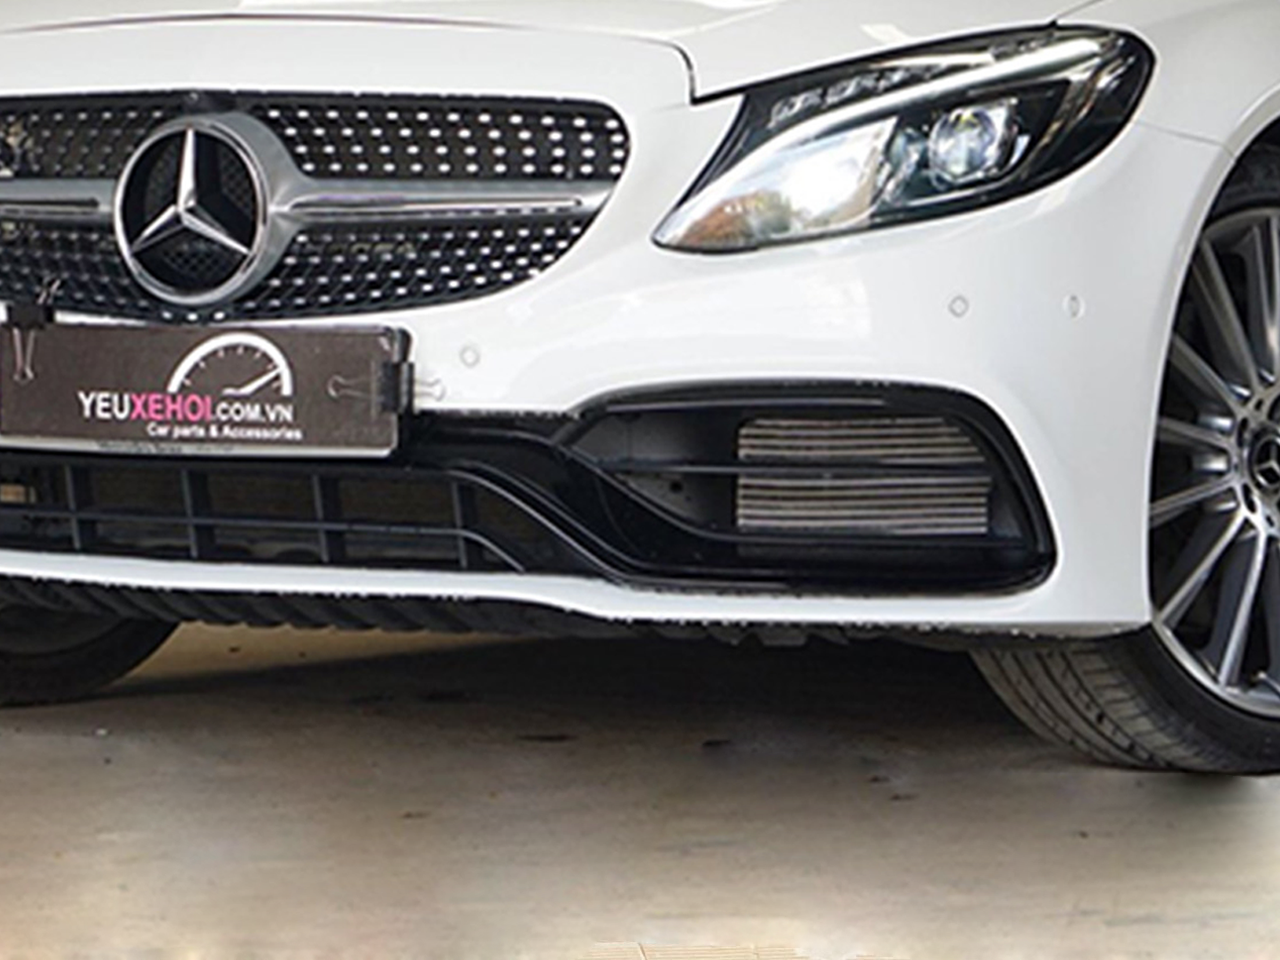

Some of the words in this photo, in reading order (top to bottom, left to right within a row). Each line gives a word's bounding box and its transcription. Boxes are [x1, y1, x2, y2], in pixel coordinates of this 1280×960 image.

[78, 391, 294, 422] YEUXEHOI.COM.VN
[146, 423, 169, 437] Car
[173, 423, 205, 438] parts
[210, 423, 219, 437] &
[222, 424, 303, 440] Accessories
